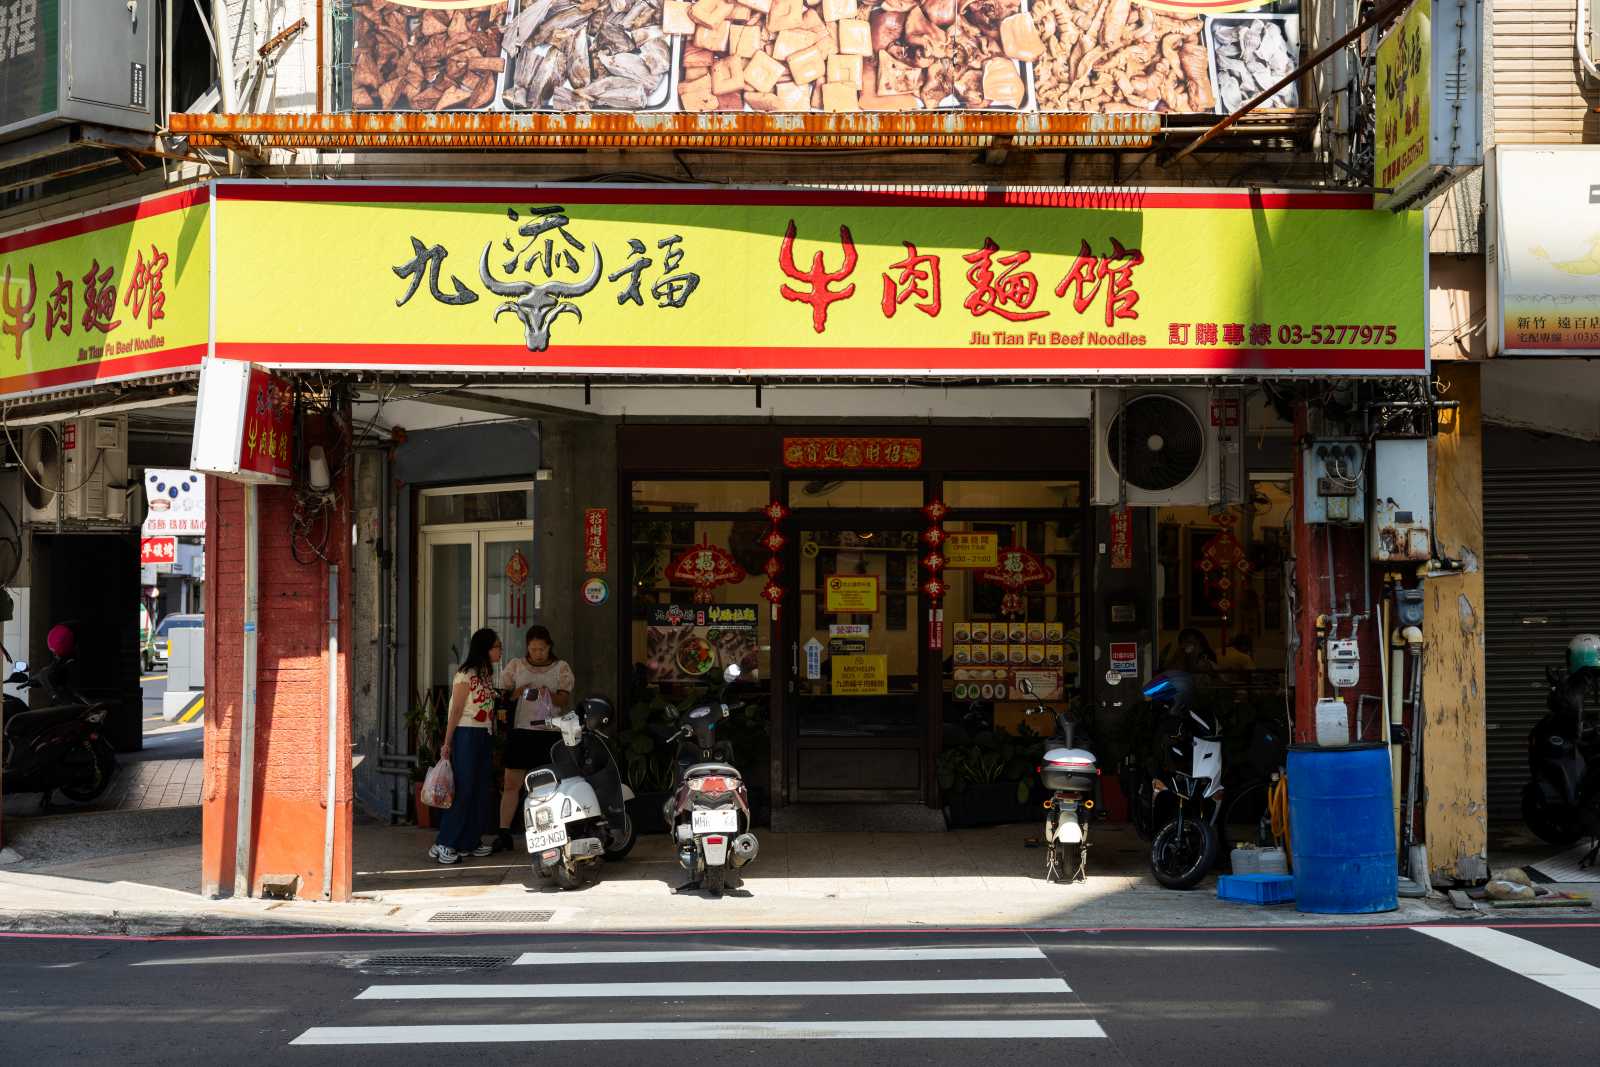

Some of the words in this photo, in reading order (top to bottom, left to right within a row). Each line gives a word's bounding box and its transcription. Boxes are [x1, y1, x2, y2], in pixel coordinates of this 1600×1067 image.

[392, 205, 700, 308] 九添福
[780, 219, 1144, 333] 牛肉麵館
[969, 332, 990, 345] Jiu
[993, 332, 1024, 345] Tian
[1028, 332, 1046, 345] Fu
[1050, 332, 1084, 345] Beef
[1087, 332, 1147, 346] Noodles
[1168, 322, 1272, 346] 訂購專線
[1277, 324, 1398, 345] 03-5277975
